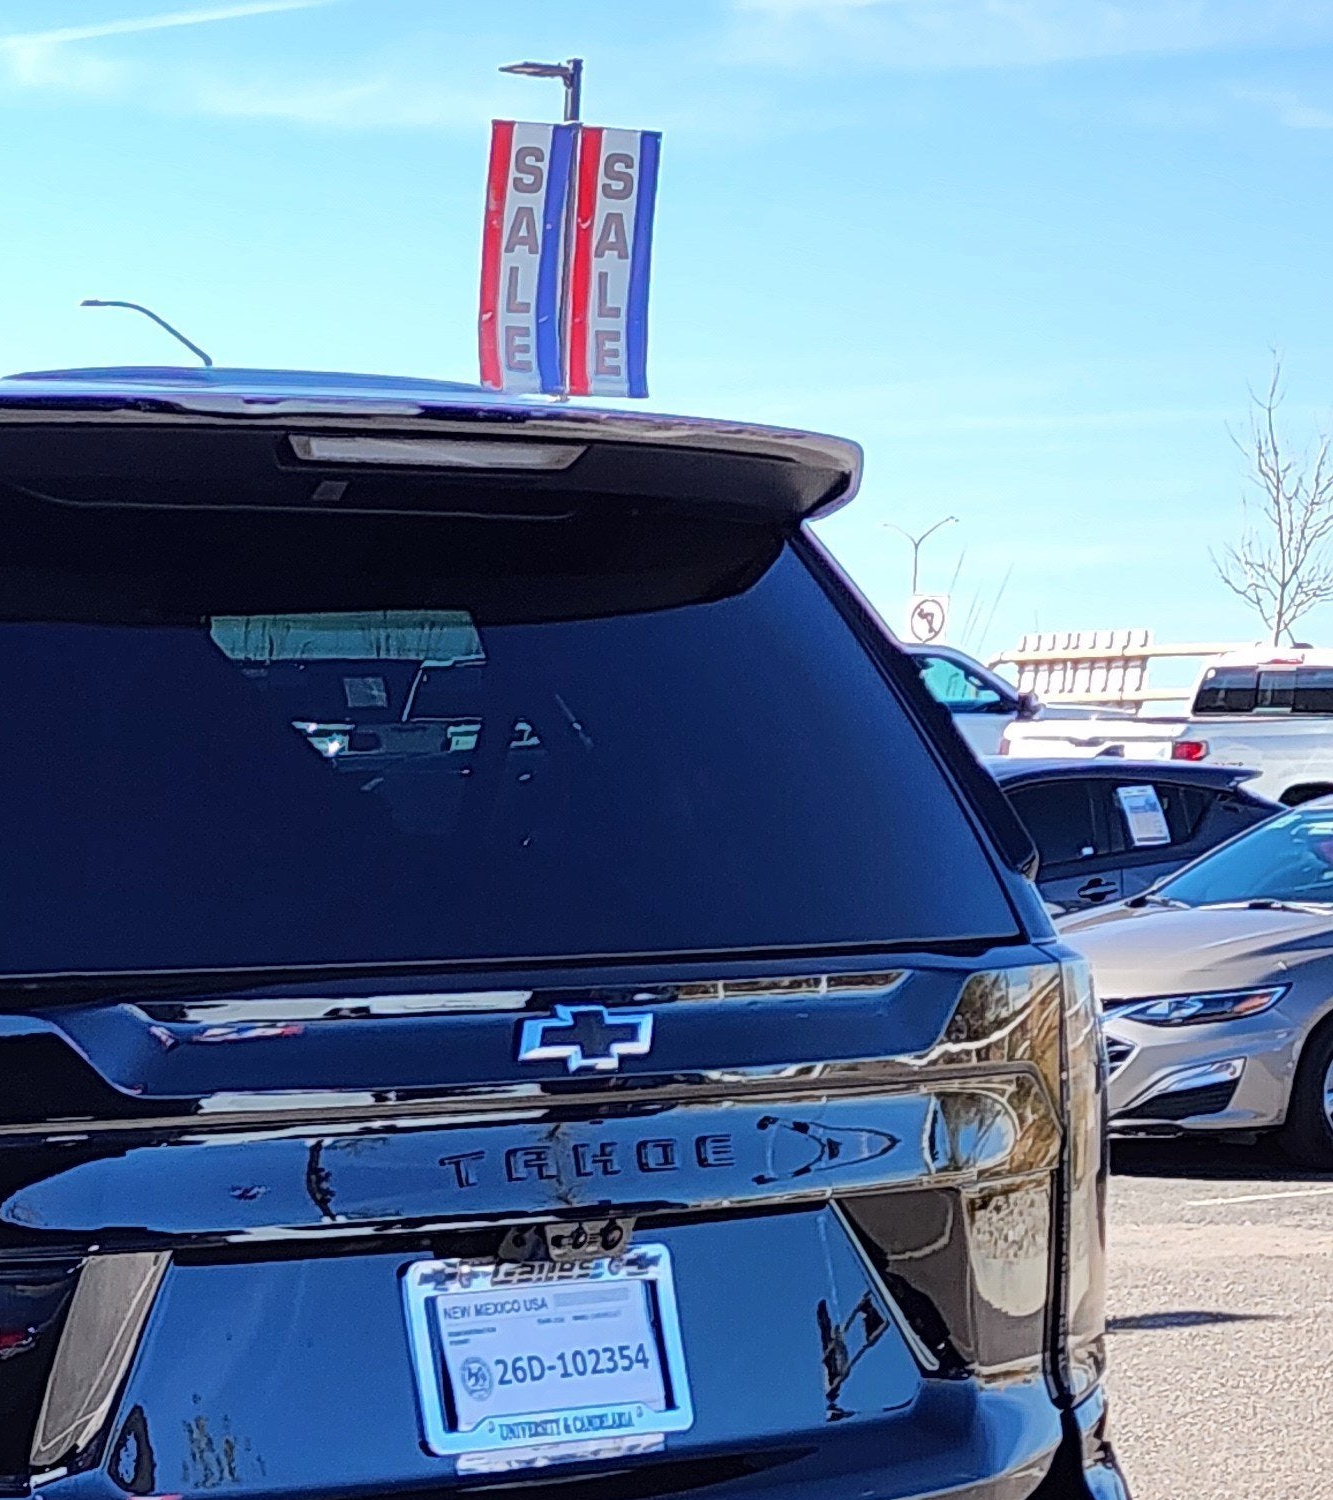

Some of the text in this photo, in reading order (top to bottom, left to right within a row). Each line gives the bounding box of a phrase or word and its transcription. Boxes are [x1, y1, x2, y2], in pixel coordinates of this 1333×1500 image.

[504, 146, 545, 373] SALE
[594, 153, 635, 376] SALE
[437, 1133, 735, 1189] TAHOE
[444, 1297, 549, 1320] NEW MEXICO USA
[494, 1343, 650, 1386] 26D-102354
